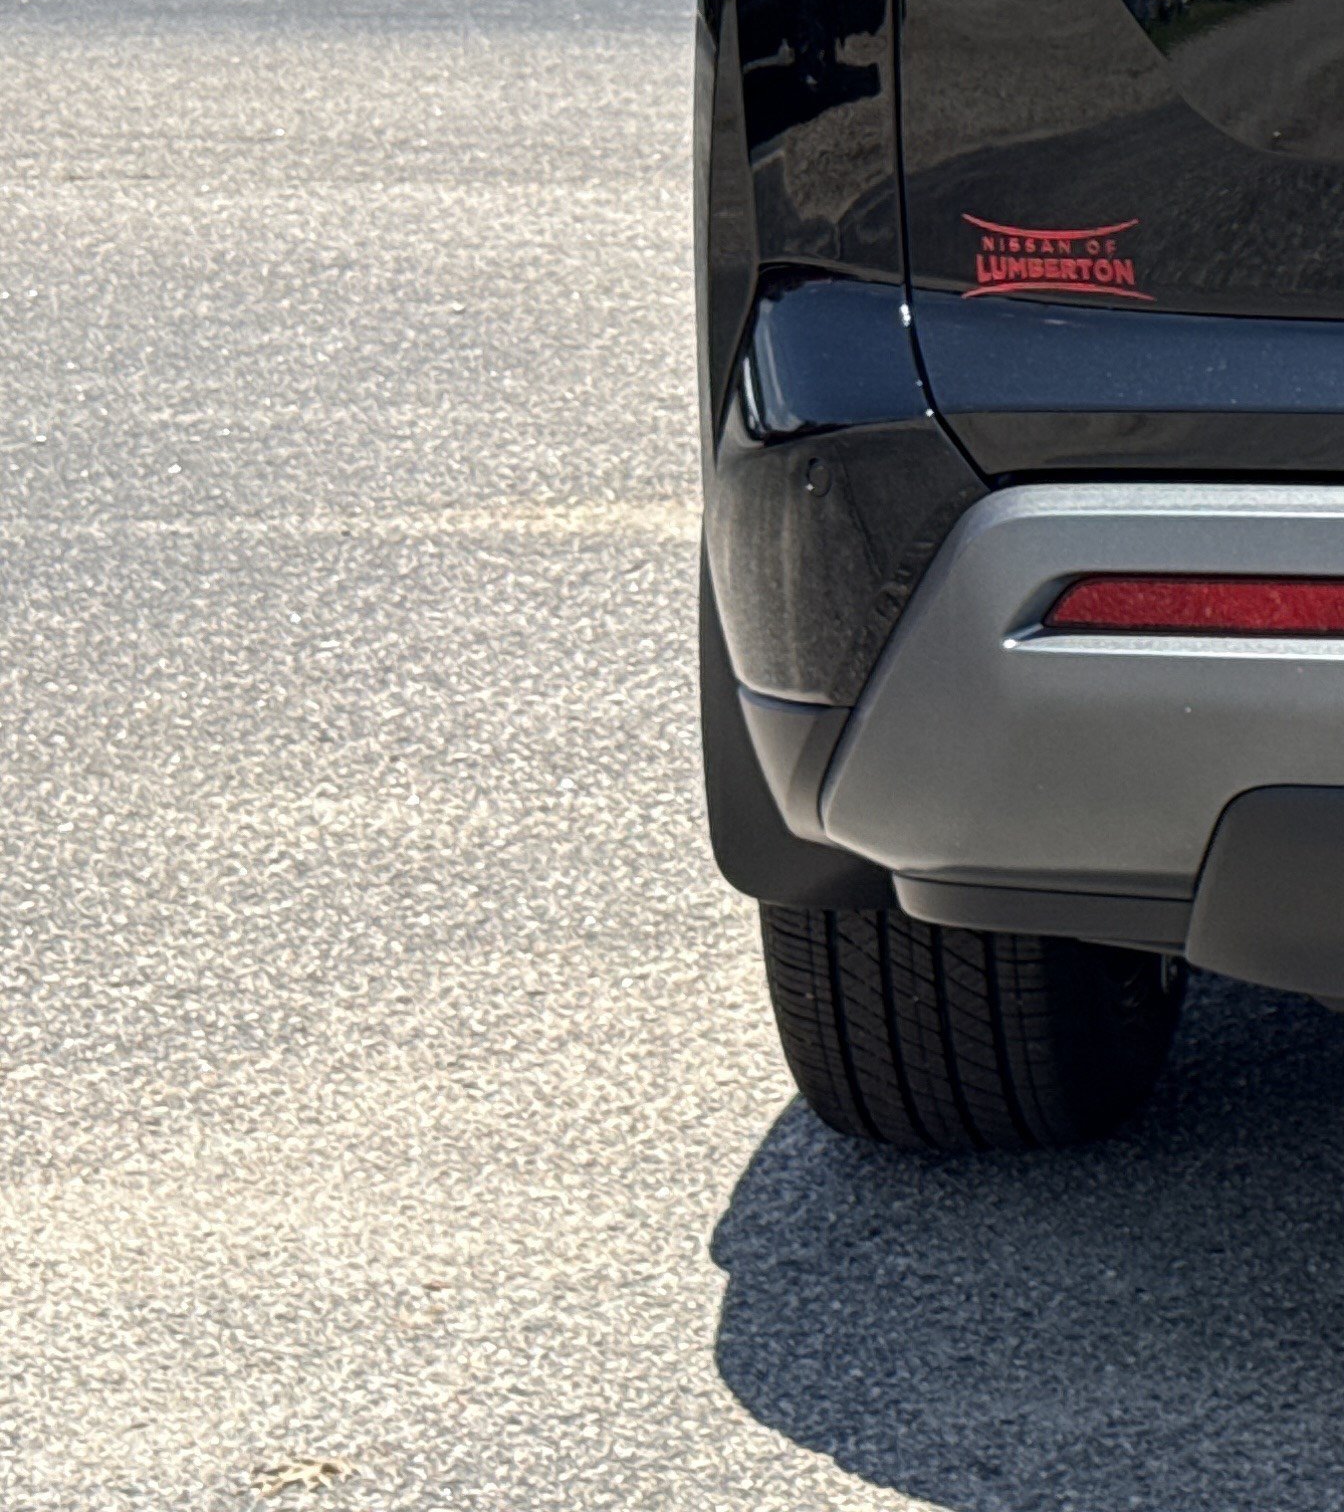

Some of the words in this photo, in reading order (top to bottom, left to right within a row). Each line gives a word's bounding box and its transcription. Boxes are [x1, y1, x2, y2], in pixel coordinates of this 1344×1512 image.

[980, 235, 1072, 254] NISSAN
[1086, 239, 1117, 255] OF
[975, 253, 1136, 285] LUMBERTON
